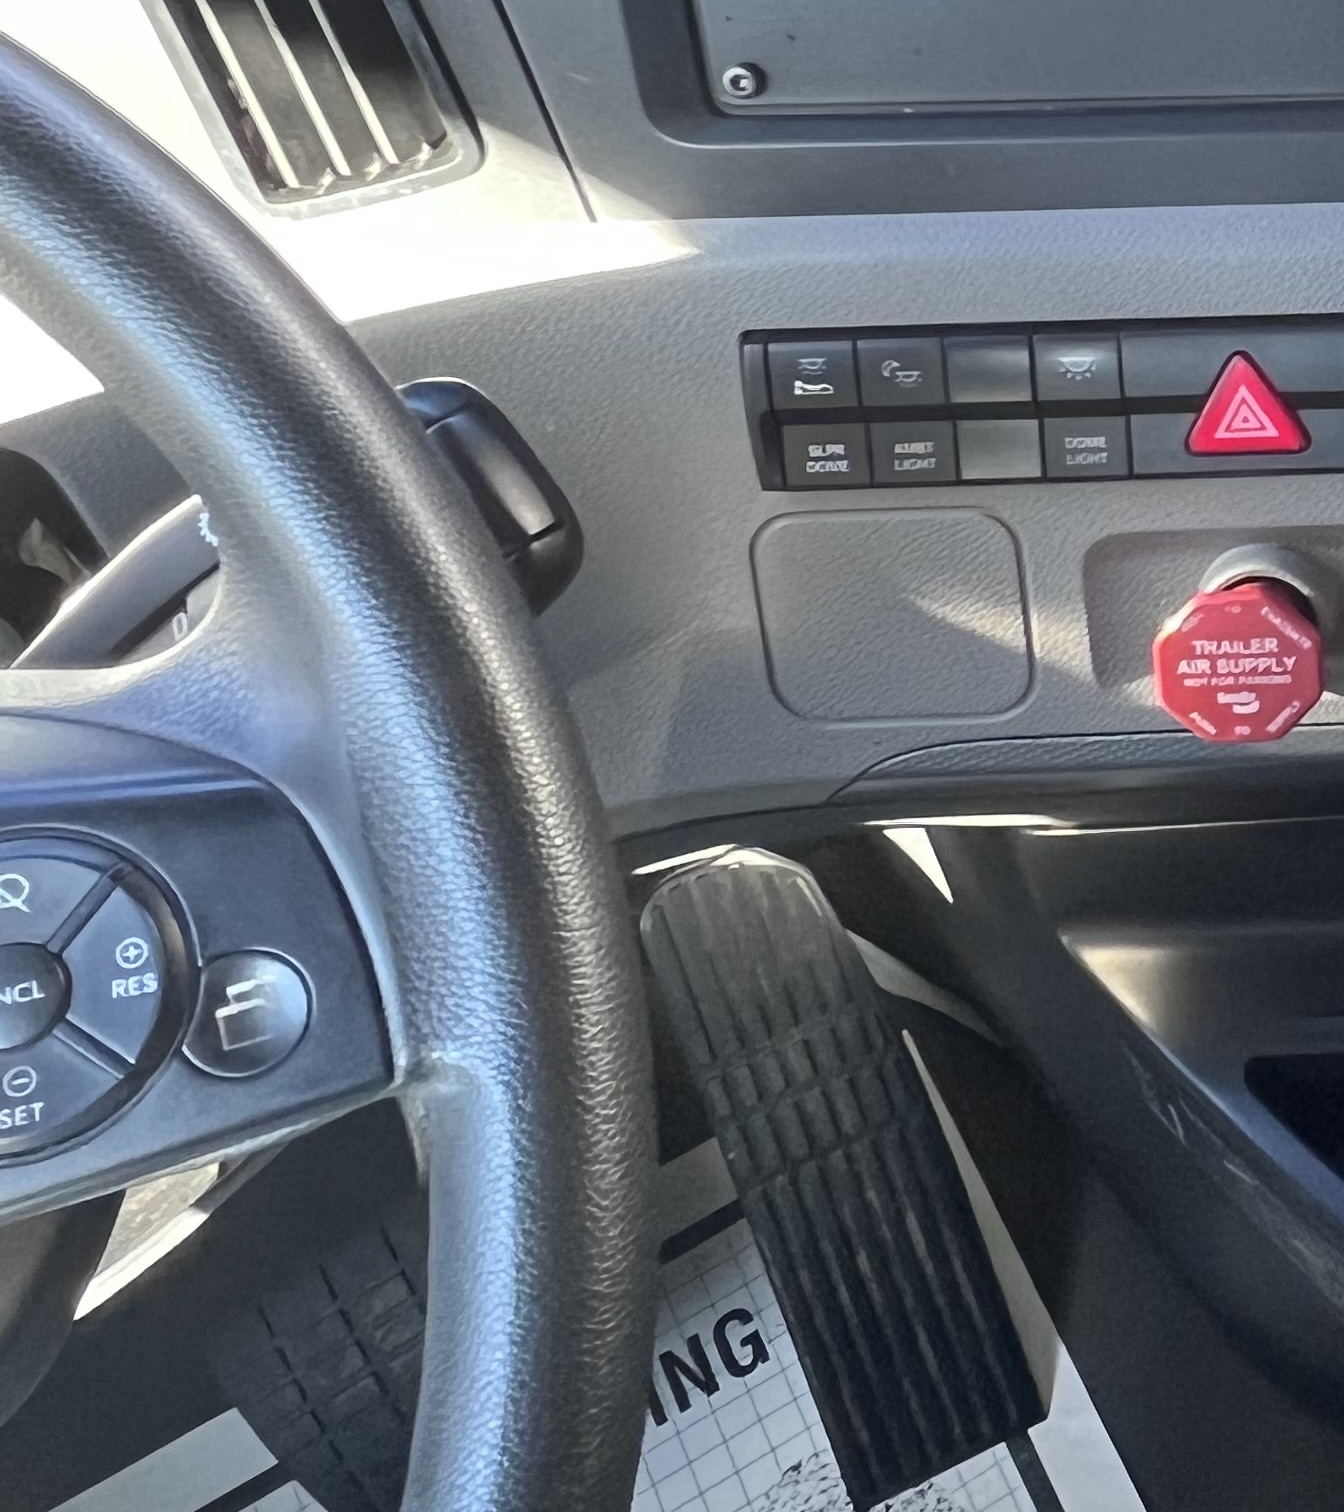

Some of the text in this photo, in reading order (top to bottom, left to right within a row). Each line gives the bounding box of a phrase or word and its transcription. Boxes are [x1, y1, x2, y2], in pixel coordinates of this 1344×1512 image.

[1191, 637, 1280, 656] TRAILER
[1176, 655, 1297, 675] AIR SUPPLY
[112, 973, 158, 998] RES
[0, 1101, 45, 1130] SET
